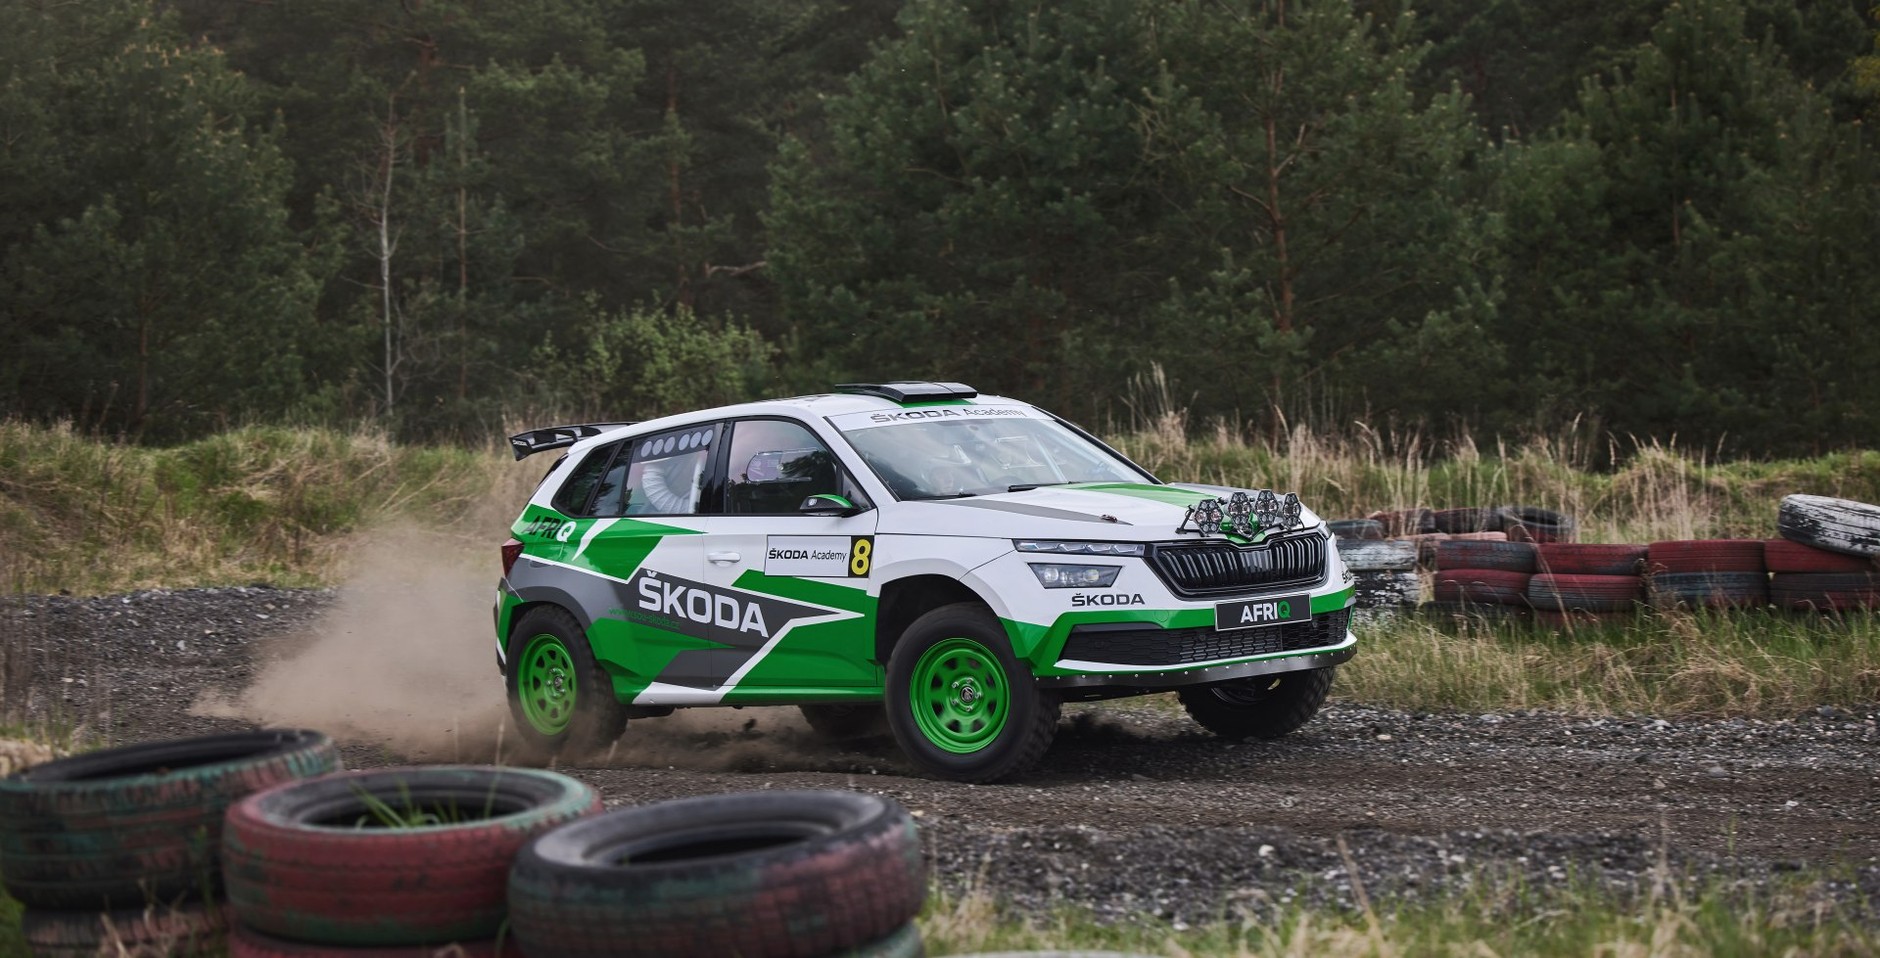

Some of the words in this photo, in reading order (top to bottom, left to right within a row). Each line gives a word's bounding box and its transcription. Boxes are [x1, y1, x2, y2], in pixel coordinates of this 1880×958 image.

[870, 408, 962, 423] ŠKODA
[964, 407, 1027, 418] Academy
[523, 515, 576, 542] AFRIQ
[768, 549, 808, 560] ŠKODA
[811, 550, 847, 562] Academy
[852, 539, 870, 575] 8
[639, 570, 769, 638] ŠKODA
[1071, 593, 1145, 606] ŠKODA
[1240, 602, 1291, 624] AFRIQ
